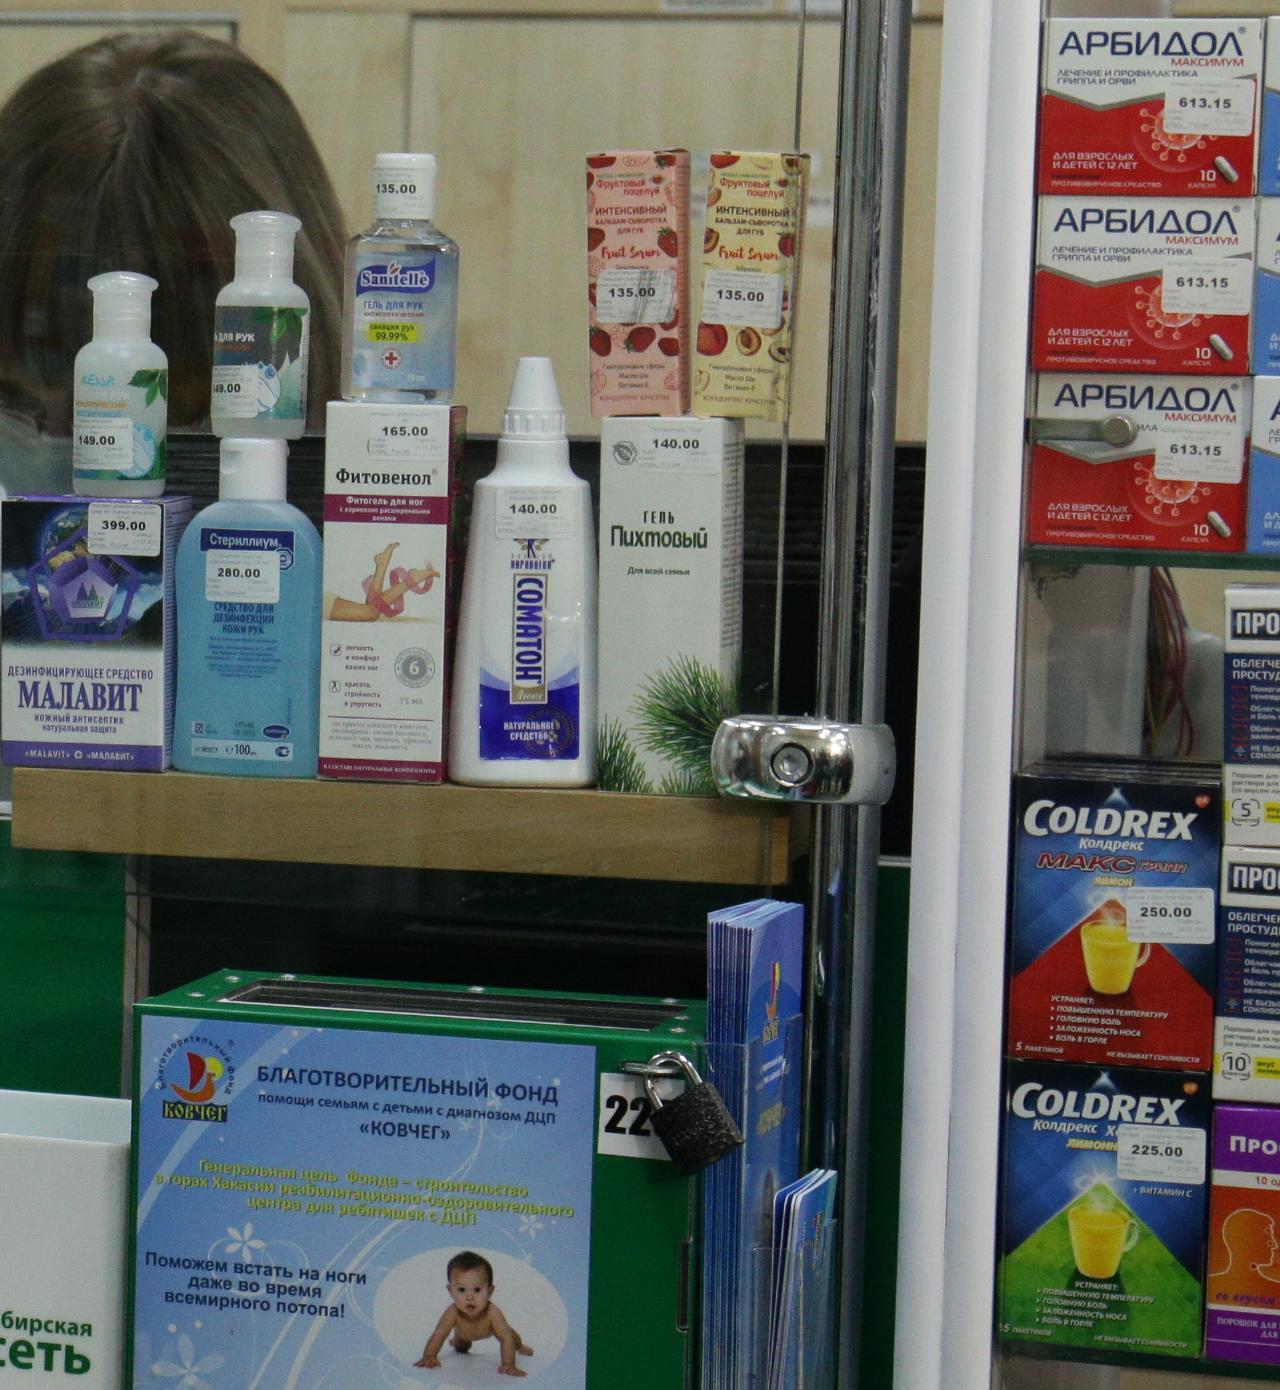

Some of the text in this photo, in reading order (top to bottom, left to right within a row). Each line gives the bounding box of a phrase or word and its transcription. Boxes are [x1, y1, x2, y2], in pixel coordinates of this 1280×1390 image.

[1058, 31, 1243, 56] АРБИДОЛ
[1171, 58, 1244, 67] МАКСИМУМ
[1057, 69, 1199, 78] ЛЕЧЕНИЕ ПРОФИЛАКТИКА
[1057, 77, 1137, 86] ГРИППА ОРВИ
[1179, 97, 1232, 109] 613.15
[1077, 151, 1134, 161] ВЗРОСЛЫХ
[1201, 169, 1217, 181] 10
[376, 183, 417, 194] 135.00
[596, 179, 646, 190] Фруктовый
[595, 205, 667, 216] ИНТЕНСИВНЫЙ
[595, 217, 668, 226] БАЛЬЗАМ-СЫВОРОТКА
[1053, 207, 1238, 235] АРБИДОЛ
[1165, 235, 1239, 246] МАКСИМУМ
[601, 245, 626, 259] Fruit
[360, 269, 430, 288] Sanitelle
[1176, 277, 1229, 289] 613.15
[608, 287, 656, 298] 135.00
[716, 289, 765, 302] 135.00
[363, 300, 424, 311] ГЕЛЬ ДЛЯ РУК
[235, 332, 255, 342] РУК
[375, 331, 409, 341] 99.99%
[1195, 347, 1211, 359] 10
[1054, 383, 1237, 413] АРБИДОЛ
[1164, 412, 1237, 424] МАКСИМУМ
[382, 426, 429, 437] 165.00
[652, 438, 700, 449] 140.00
[1170, 443, 1222, 456] 613.15
[336, 467, 432, 486] Фитовенол
[346, 496, 425, 507] Фитогель для ног
[509, 503, 557, 514] 140.00
[101, 520, 147, 532] 399.00
[1193, 524, 1209, 535] 10
[209, 533, 278, 548] Стериллиум
[611, 525, 708, 549] Пихтовый
[217, 567, 261, 578] 280.00
[627, 566, 690, 576] Для всей семьи
[515, 577, 544, 682] СОМАТОН
[7, 664, 154, 681] ДЕЗИНФИЦИРУЮЩЕЕ СРЕДСТВО
[18, 680, 143, 712] МАЛАВИТ
[73, 715, 125, 725] антисептик
[503, 721, 555, 731] НАТУРАЛЬНОЕ
[235, 744, 251, 756] 100
[1023, 799, 1199, 841] COLDREX
[1079, 838, 1145, 852] Колдрекс
[1036, 852, 1137, 873] МАКС
[1140, 906, 1192, 918] 250.00
[1056, 1005, 1169, 1019] ПОВЫШЕННУЮ ТЕМПЕРАТУРУ
[1100, 1018, 1122, 1027] БОЛЬ
[1056, 1024, 1142, 1037] ЗАЛОЖЕННОСТЬ НОСА
[1226, 1056, 1247, 1071] 10
[257, 1066, 559, 1106] БЛАГОТВОРИТЕЛЬНЫЙ ФОНД
[258, 1092, 556, 1126] помощи семьям с детьми с диагнозом ДЦП
[1012, 1082, 1186, 1126] COLDREX
[163, 1102, 227, 1121] КОВЧЕГ
[360, 1120, 451, 1141] «КОВЧЕГ»
[1132, 1144, 1184, 1157] 225.00
[199, 1159, 529, 1199] Генеральная цель Фонда строительство
[1256, 1176, 1267, 1185] 10
[155, 1173, 164, 1185] в
[168, 1174, 209, 1190] горах
[280, 1181, 575, 1218] реабилитационно-оздоровительного
[1140, 1186, 1185, 1198] ВИТАМИН
[248, 1196, 477, 1227] центра для ребятишек с ДЦП
[145, 1251, 367, 1286] Поможем встать на ноги
[188, 1275, 322, 1299] даже во время
[164, 1290, 345, 1318] всемирного потопа!
[1217, 1316, 1258, 1328] ПОРОШОК
